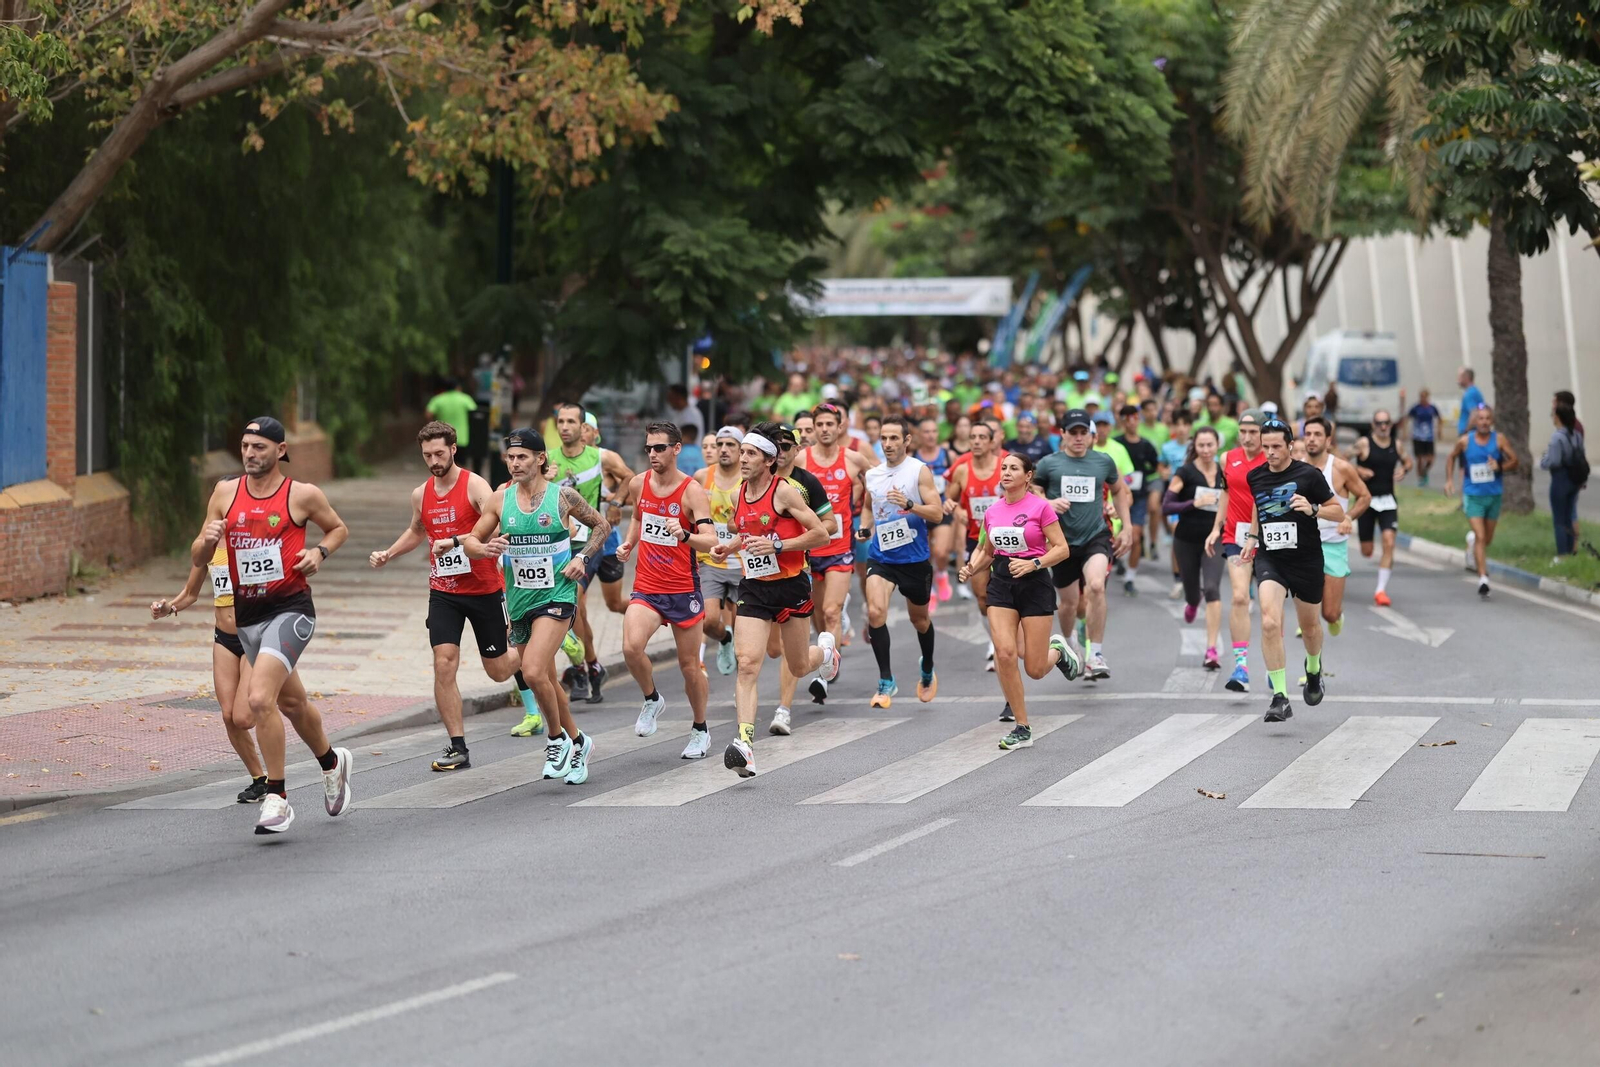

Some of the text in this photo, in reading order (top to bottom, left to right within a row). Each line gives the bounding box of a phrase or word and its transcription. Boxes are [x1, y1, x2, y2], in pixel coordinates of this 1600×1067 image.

[1066, 485, 1089, 494] 305
[645, 523, 671, 537] 273
[881, 528, 905, 543] 278
[510, 535, 550, 544] ATLETISMO
[994, 536, 1020, 546] 538
[1266, 532, 1289, 542] 931
[508, 545, 557, 555] ORREMOLINOS
[242, 559, 274, 574] 732
[438, 554, 462, 567] 894
[747, 556, 771, 569] 624
[518, 568, 546, 580] 403
[214, 576, 228, 588] 47
